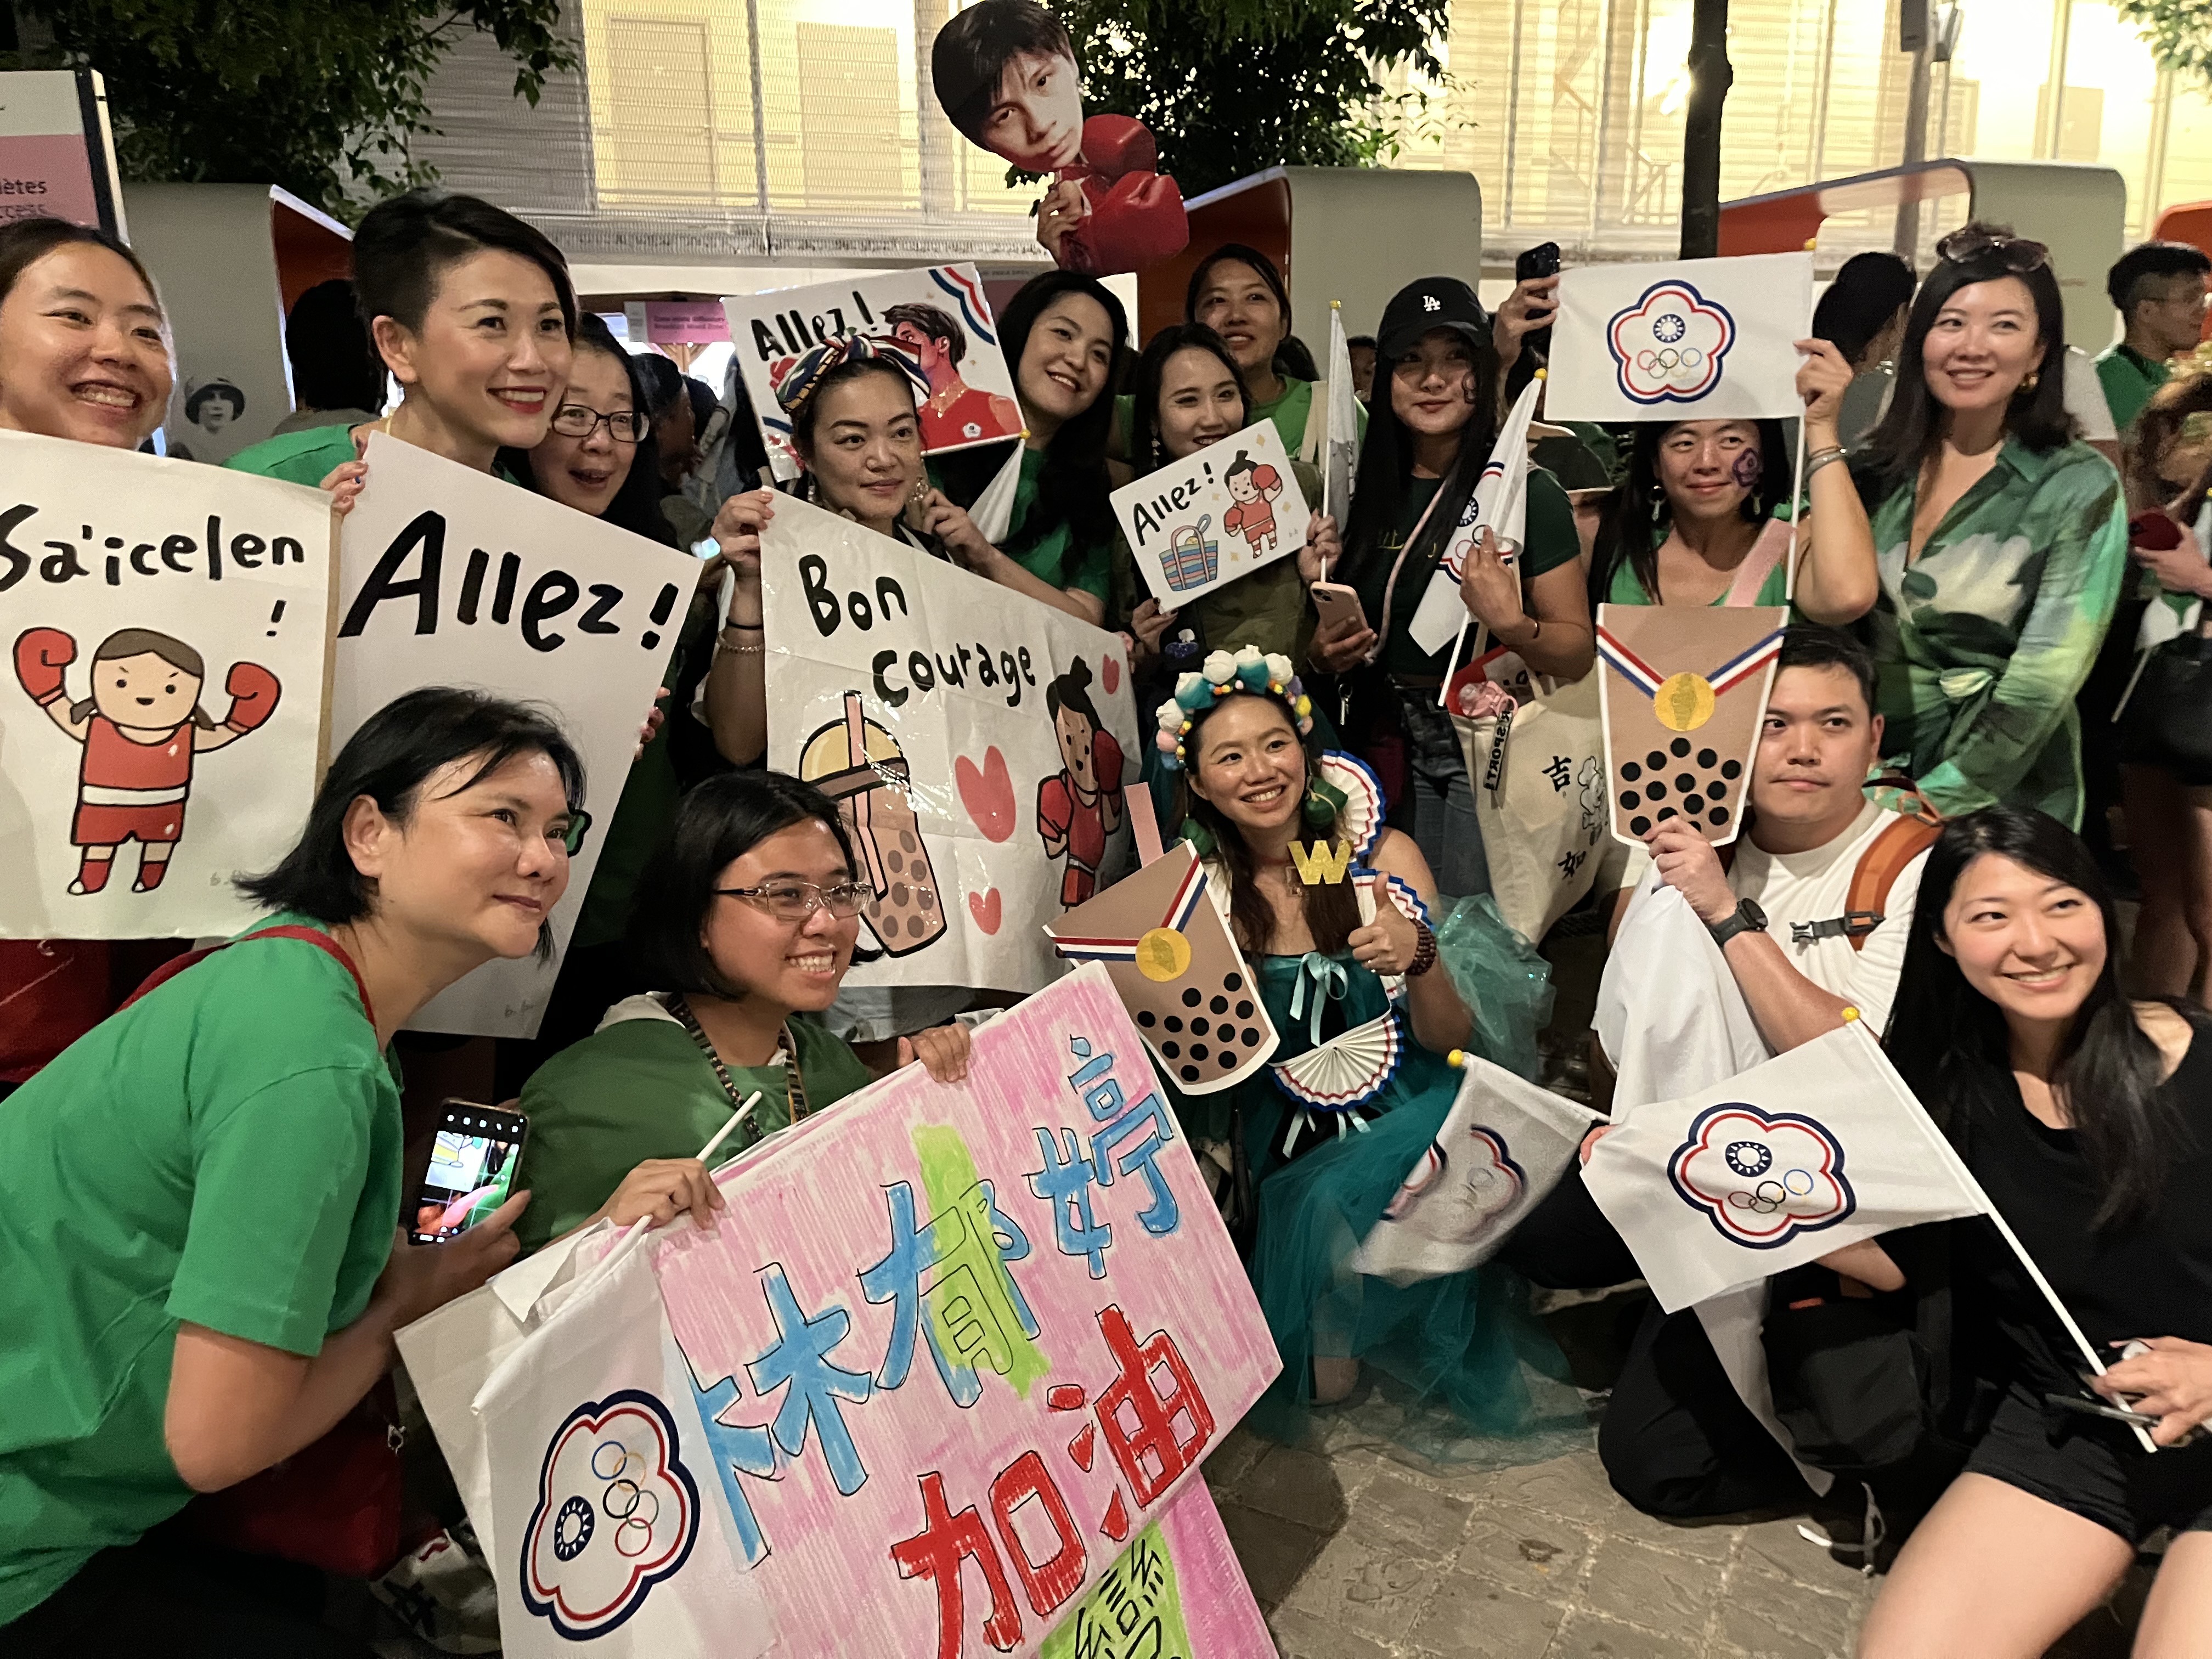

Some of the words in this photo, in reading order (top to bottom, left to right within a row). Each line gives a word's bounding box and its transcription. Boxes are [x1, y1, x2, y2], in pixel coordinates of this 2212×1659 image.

[0, 178, 48, 194] ètes
[1423, 295, 1441, 311] LA
[798, 554, 907, 637] Bon
[890, 1304, 1215, 1659] 加油
